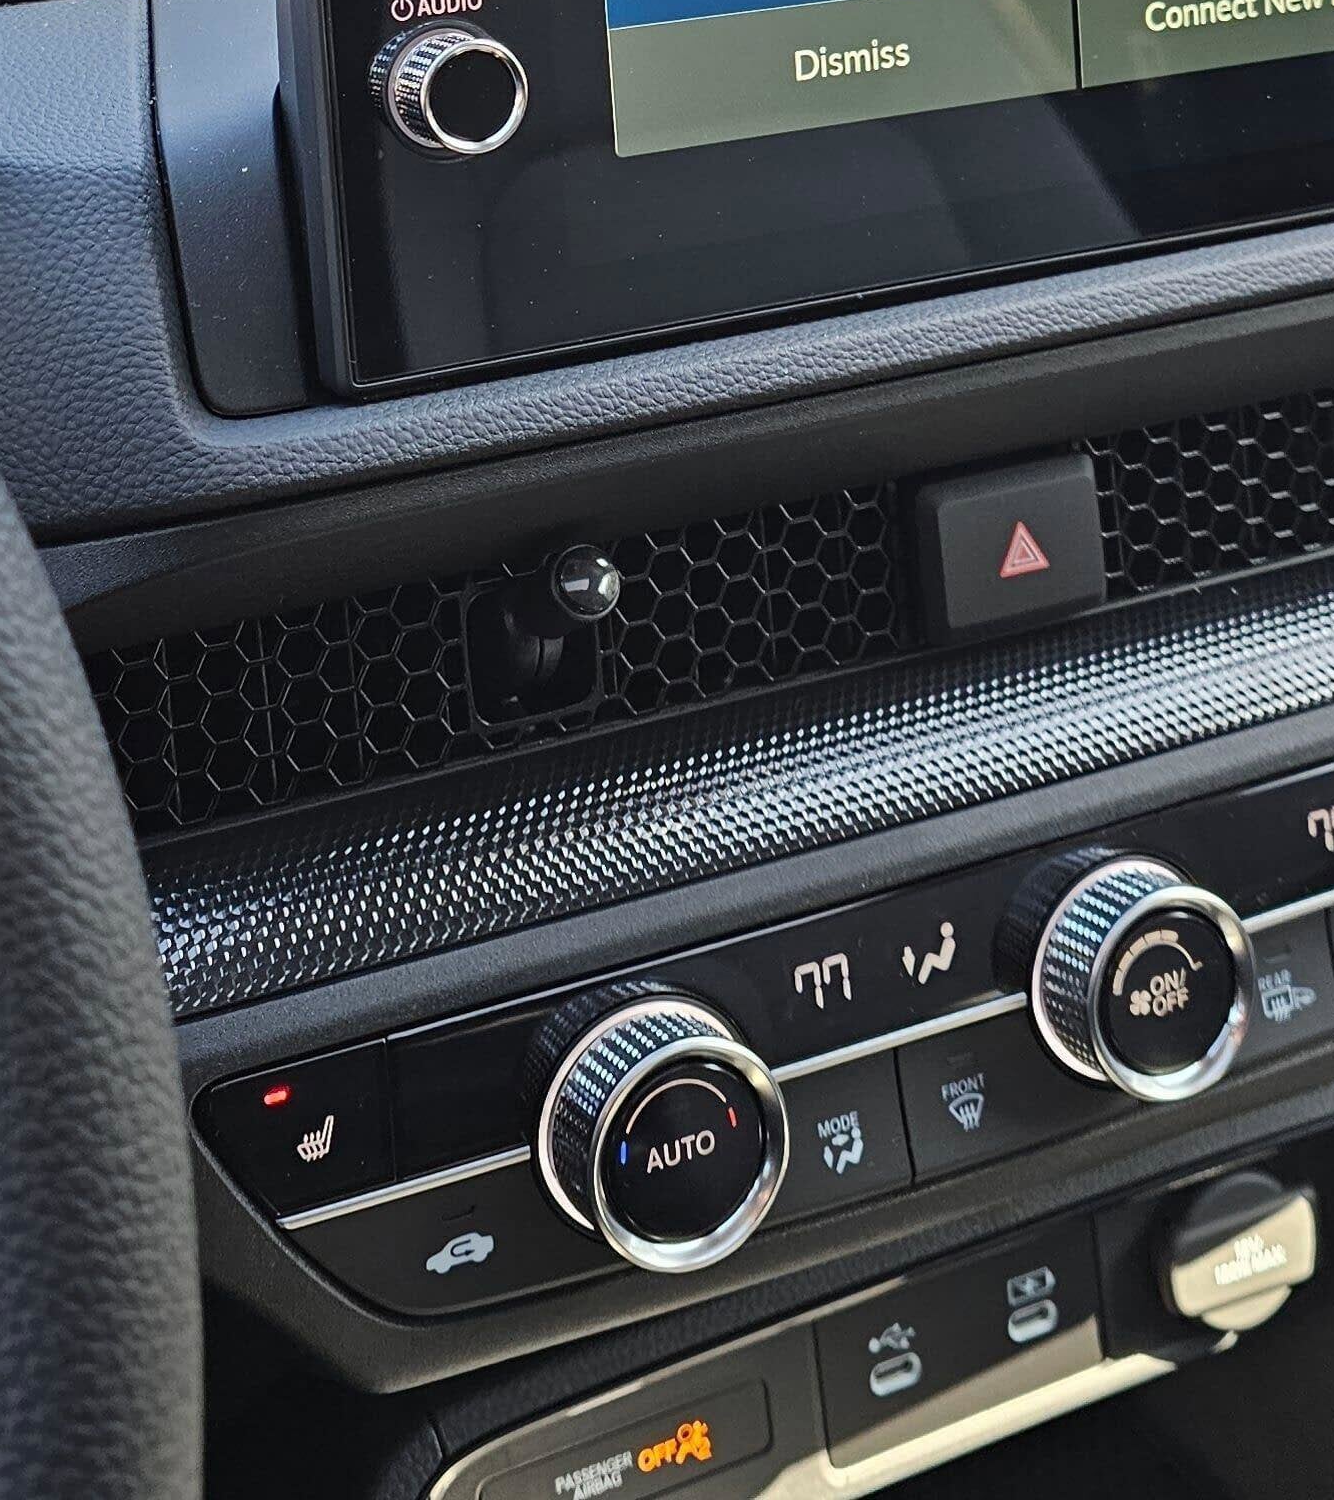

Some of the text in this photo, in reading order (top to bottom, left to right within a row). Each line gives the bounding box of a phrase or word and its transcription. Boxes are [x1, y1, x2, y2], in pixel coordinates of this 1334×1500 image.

[795, 39, 910, 81] Dismiss
[795, 953, 851, 1008] 77
[1257, 969, 1292, 991] REAR
[1152, 987, 1189, 1017] OFF
[942, 1074, 985, 1100] FRONT
[818, 1112, 859, 1139] MODE
[647, 1130, 715, 1173] AUTO
[554, 1438, 678, 1495] PASSENGER OFF
[573, 1469, 624, 1500] AIRBAG
